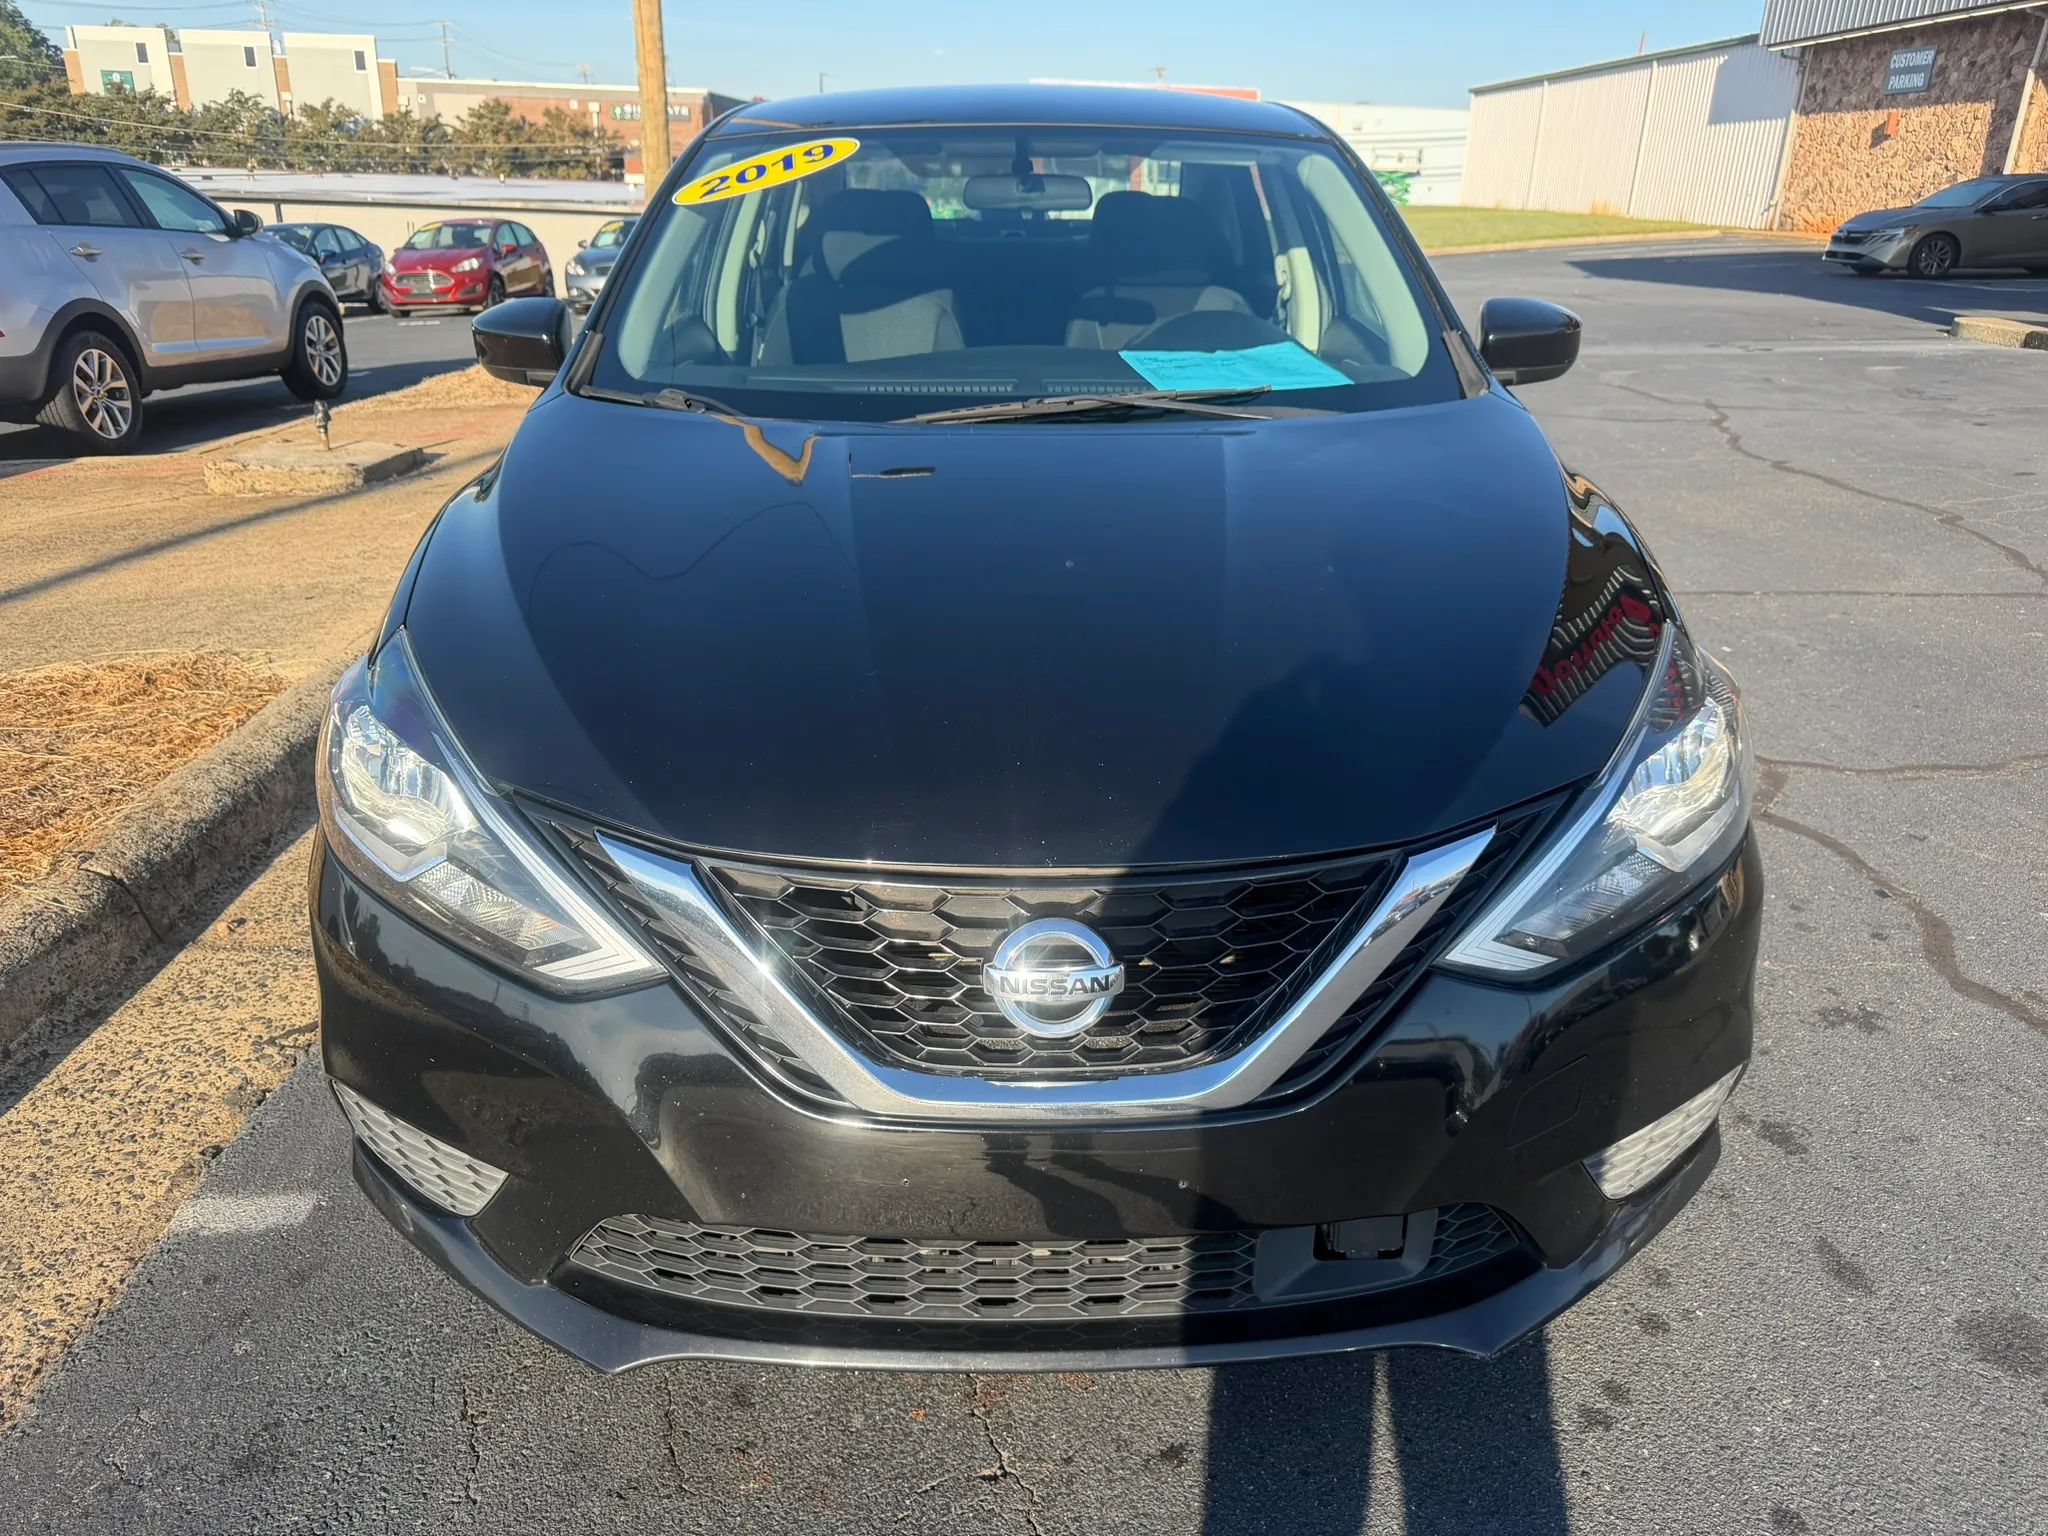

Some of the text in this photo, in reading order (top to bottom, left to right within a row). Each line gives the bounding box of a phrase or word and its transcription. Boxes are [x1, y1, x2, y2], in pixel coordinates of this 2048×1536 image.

[1890, 50, 1935, 69] CUSTOMER
[1887, 72, 1925, 90] PARKING
[699, 144, 835, 200] 2019
[999, 974, 1111, 996] NISSAN
